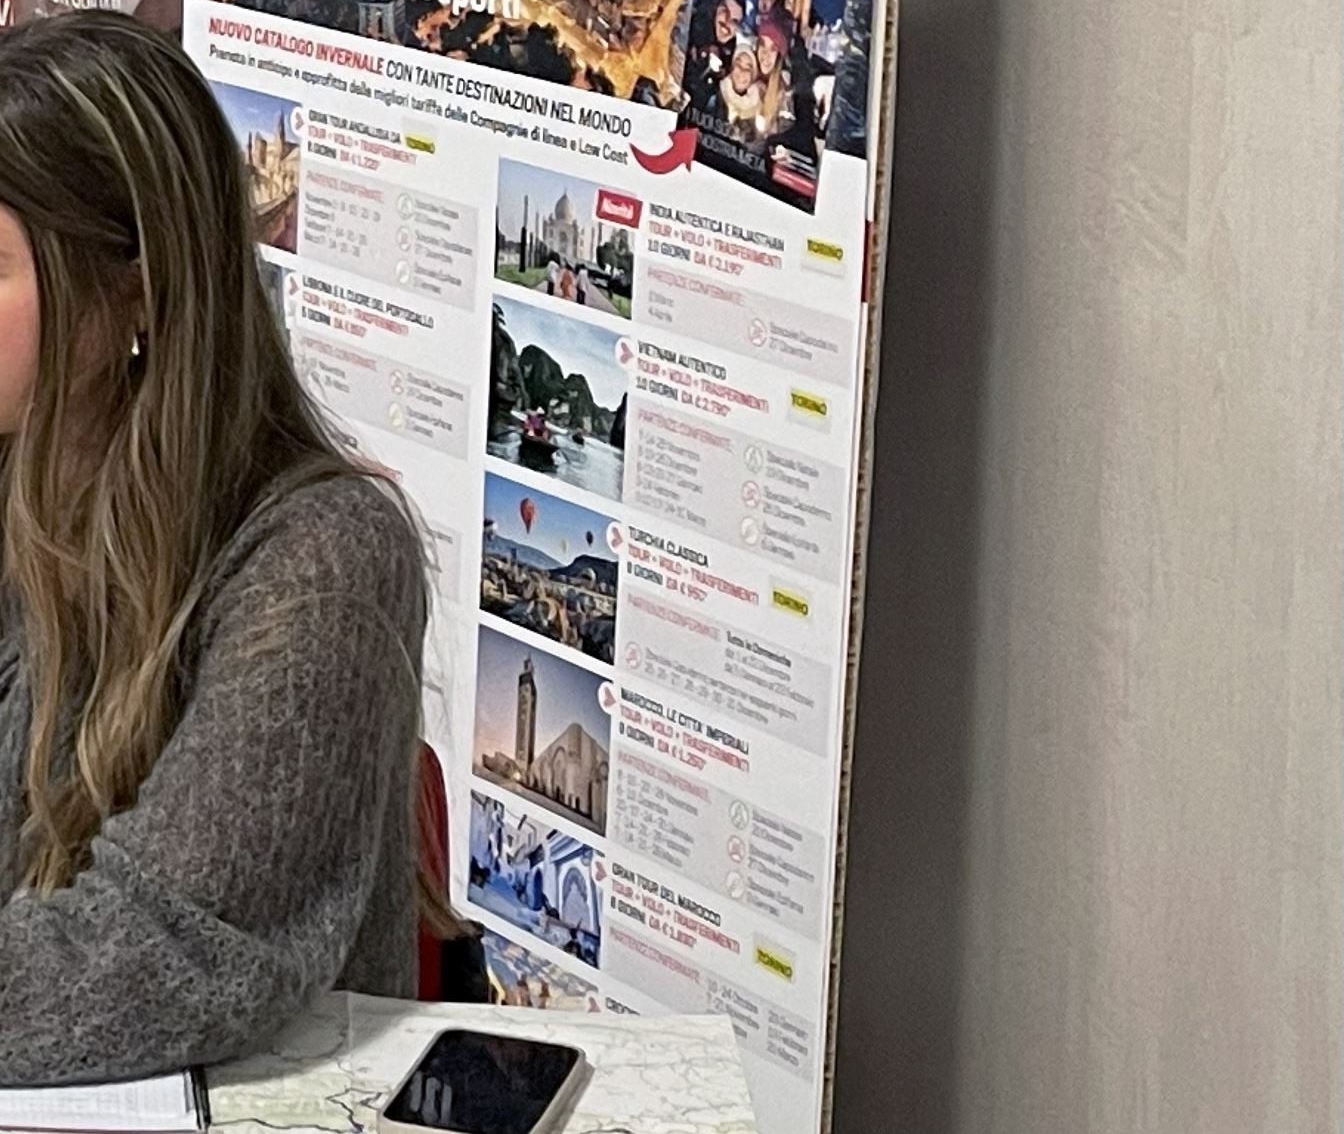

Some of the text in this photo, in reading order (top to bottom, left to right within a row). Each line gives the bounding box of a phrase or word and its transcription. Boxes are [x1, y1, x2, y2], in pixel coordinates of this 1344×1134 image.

[208, 17, 632, 138] NUOVO CATALOGO INVERNALE CON TANTE DESTINAZIONI NEL MONDO
[530, 125, 541, 142] di
[648, 220, 672, 239] TOUR
[681, 229, 705, 246] VOLO
